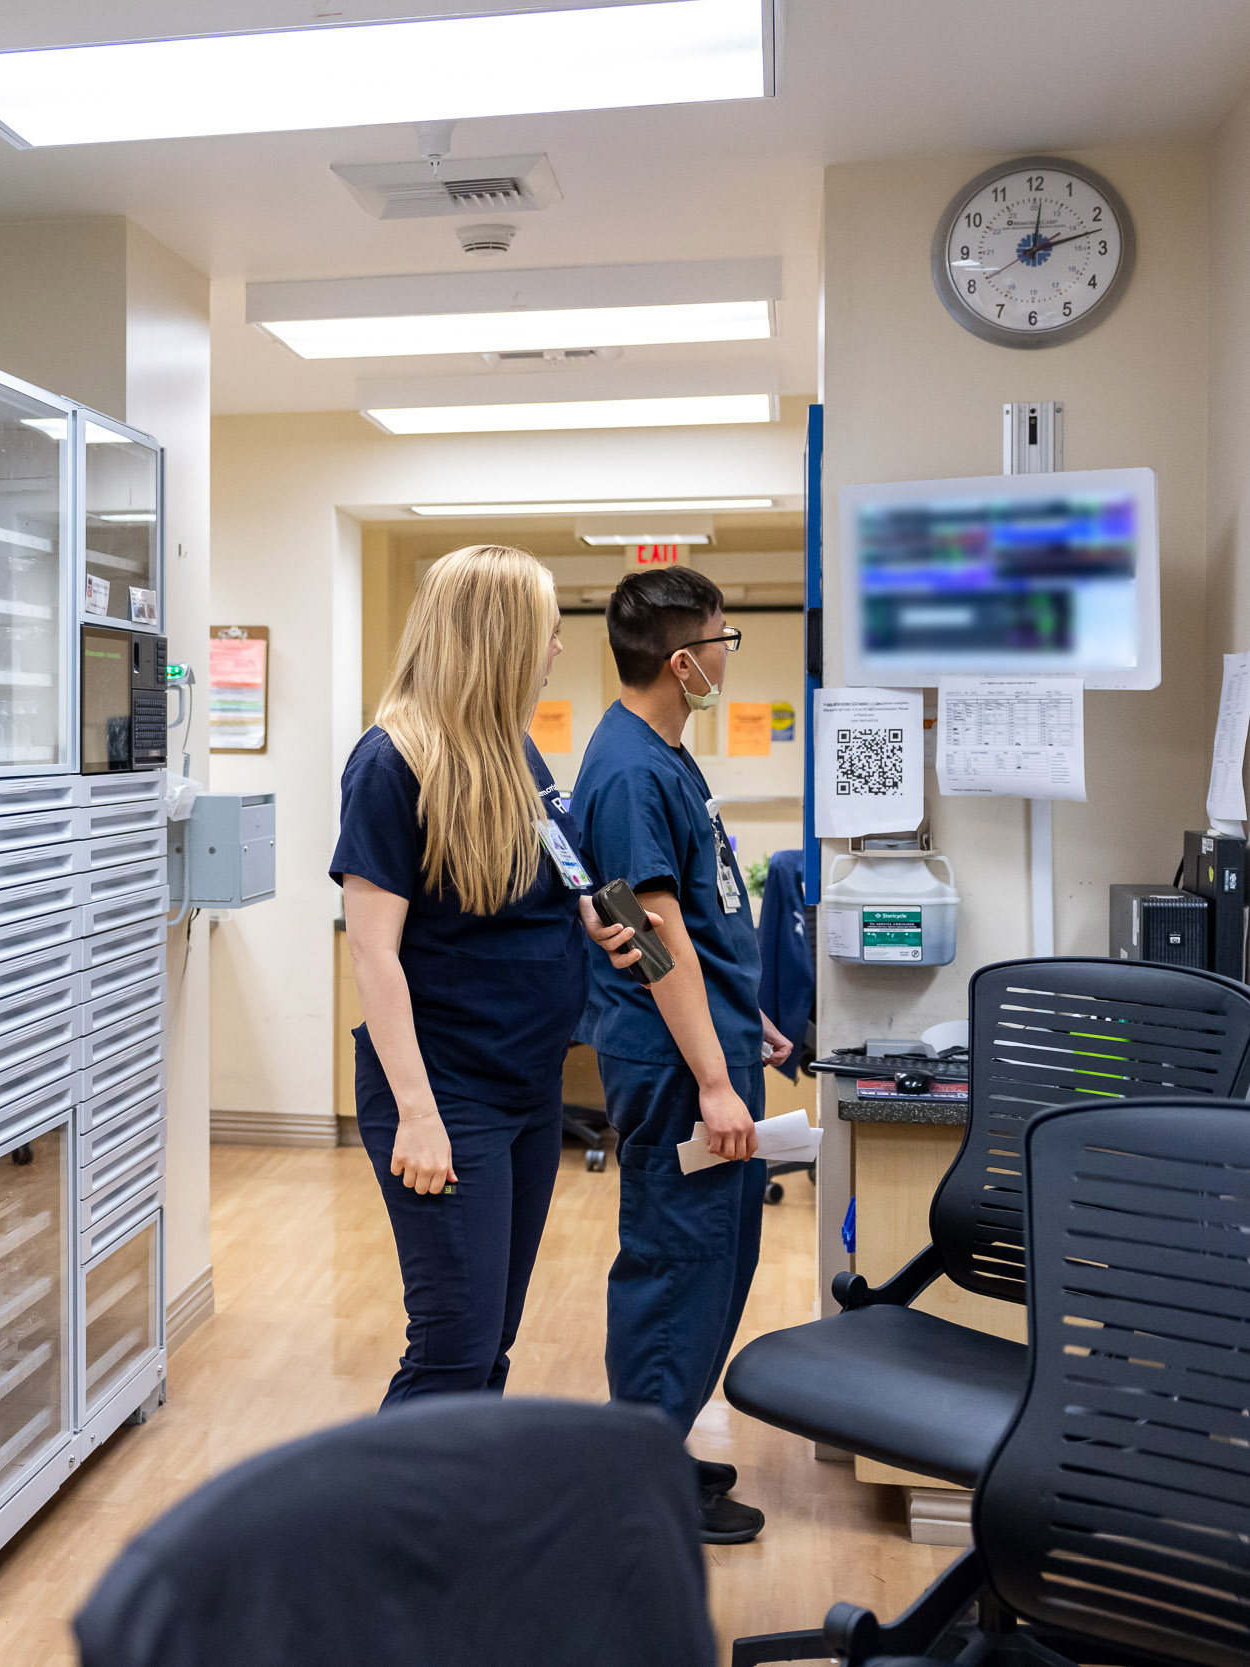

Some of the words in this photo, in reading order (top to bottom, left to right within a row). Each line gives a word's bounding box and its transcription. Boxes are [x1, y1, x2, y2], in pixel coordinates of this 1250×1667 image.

[1027, 176, 1044, 192] 12
[1066, 182, 1073, 197] 1
[992, 187, 1006, 202] 11
[964, 213, 982, 228] 10
[1093, 207, 1102, 222] 2
[961, 246, 969, 260] 9
[1098, 241, 1107, 255] 3
[968, 279, 976, 294] 8
[1087, 275, 1097, 289] 4
[996, 304, 1005, 318] 7
[1063, 302, 1072, 316] 5
[1028, 311, 1037, 326] 6
